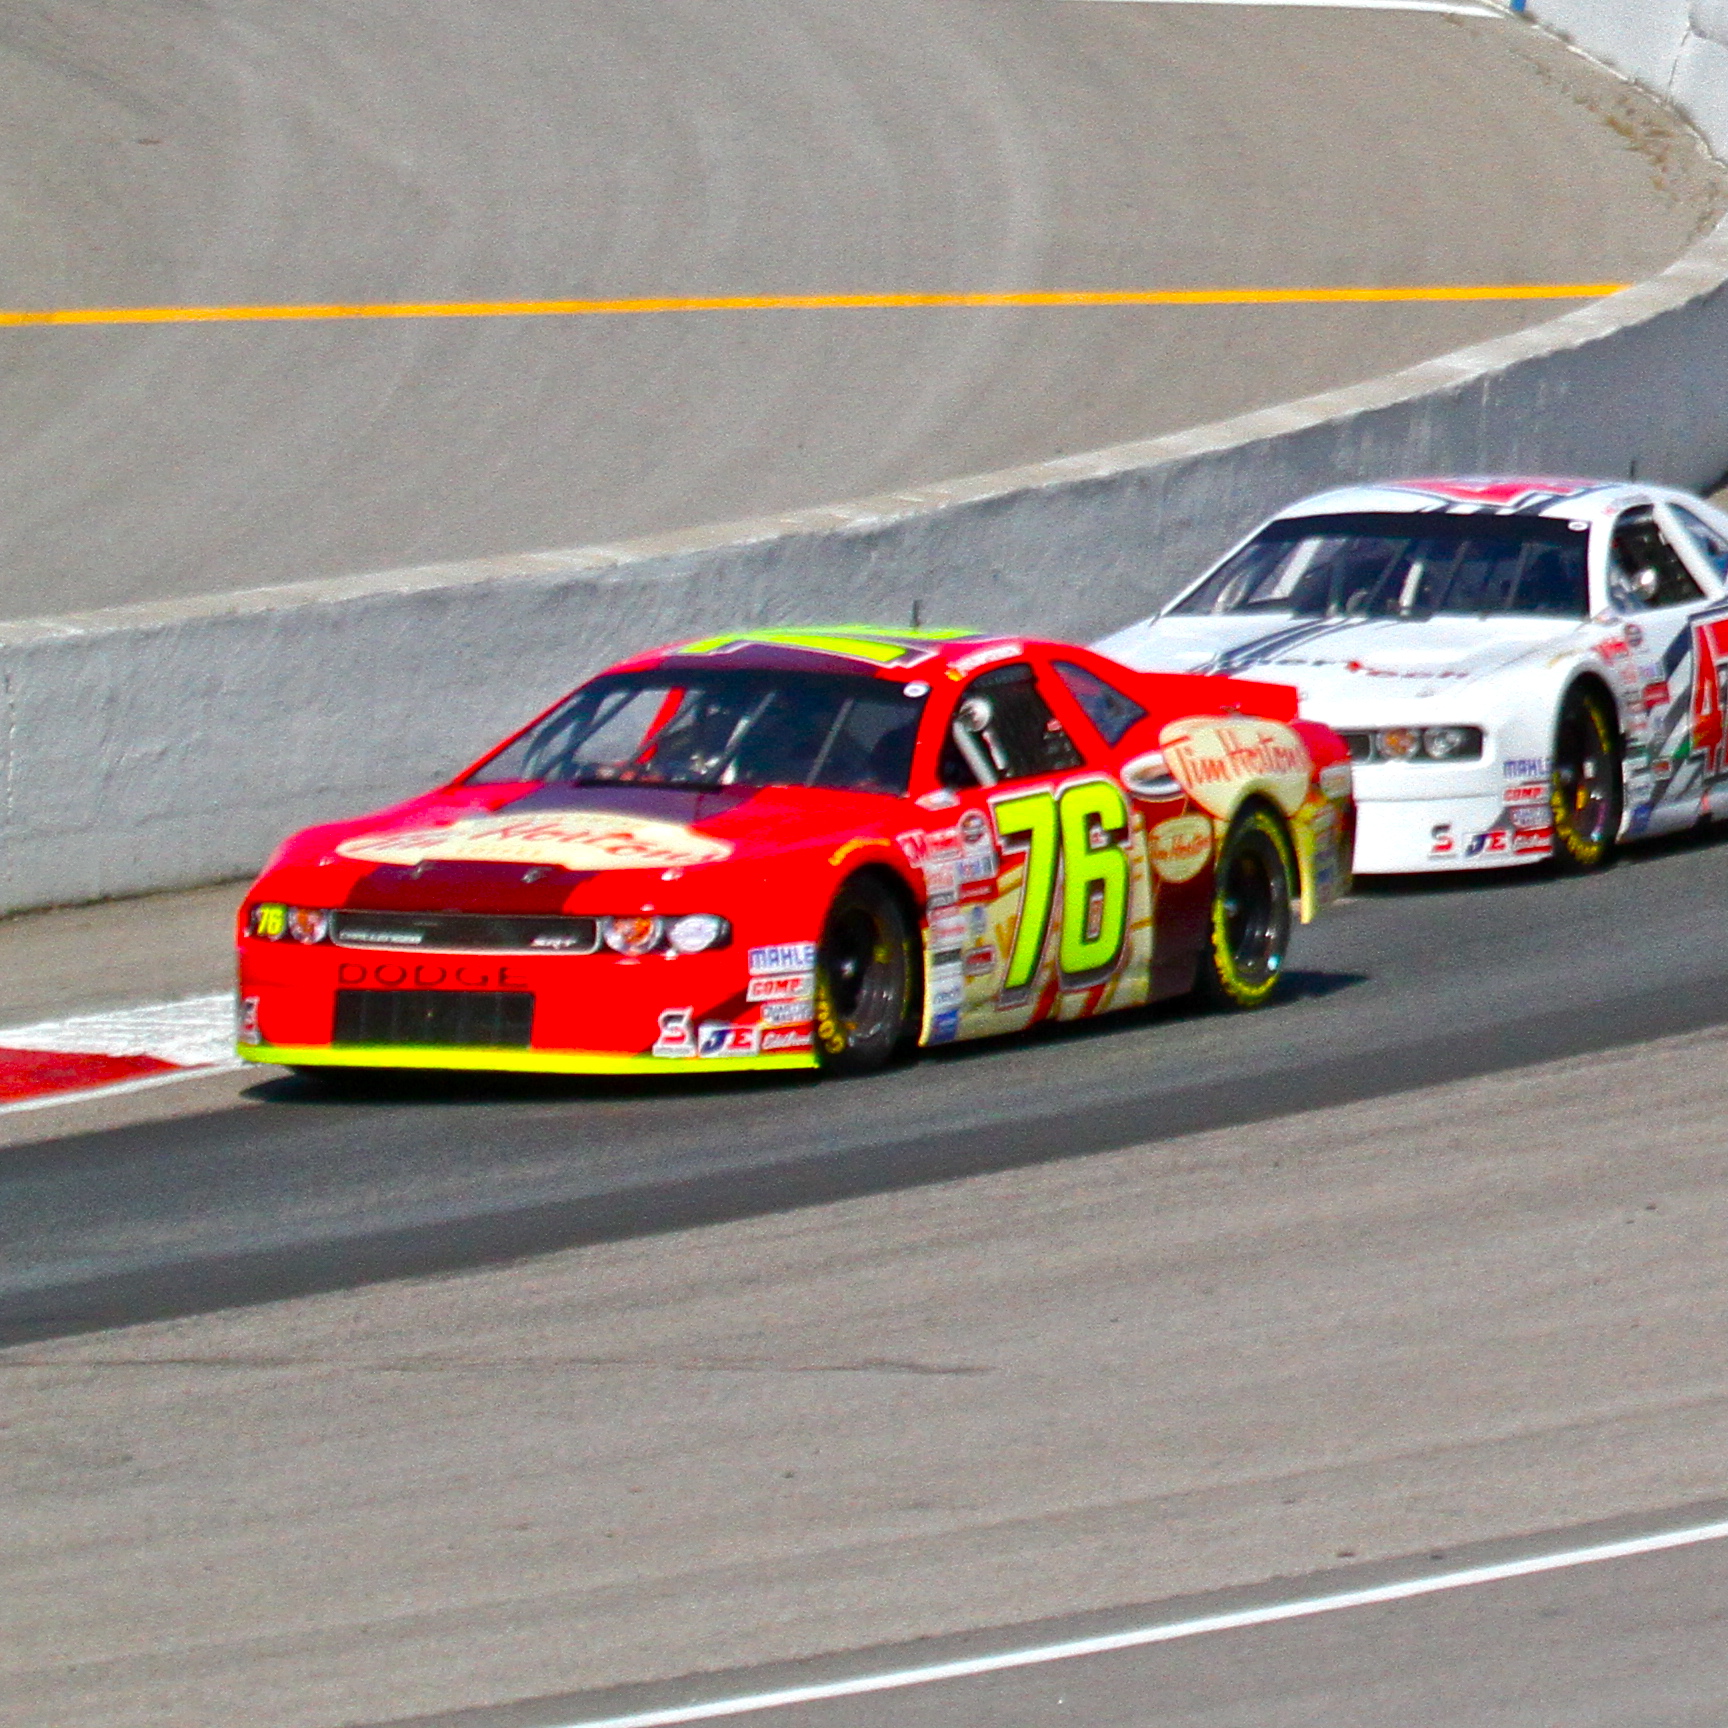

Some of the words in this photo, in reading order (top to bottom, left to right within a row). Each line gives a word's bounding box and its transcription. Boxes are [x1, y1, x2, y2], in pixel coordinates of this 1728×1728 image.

[994, 781, 1130, 992] 76
[255, 903, 284, 937] 76
[750, 945, 816, 970] MAHLE
[337, 962, 530, 988] DODGE
